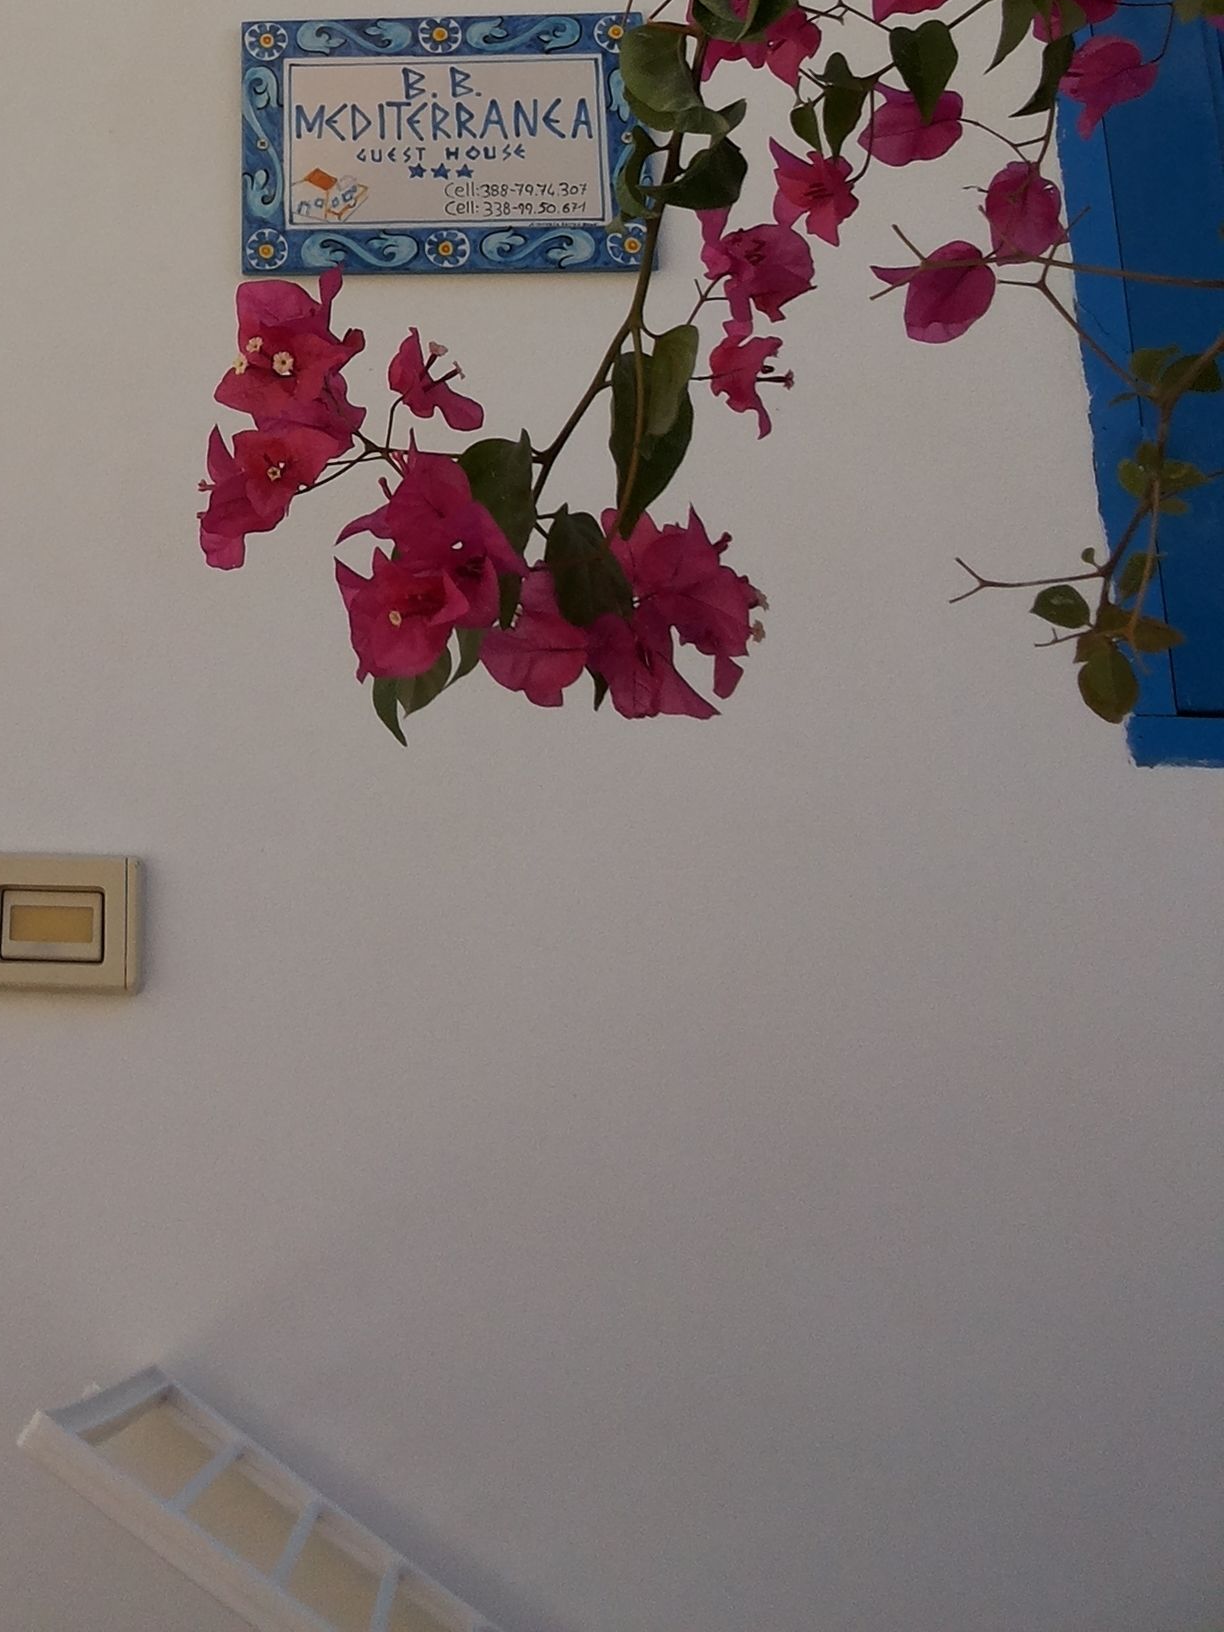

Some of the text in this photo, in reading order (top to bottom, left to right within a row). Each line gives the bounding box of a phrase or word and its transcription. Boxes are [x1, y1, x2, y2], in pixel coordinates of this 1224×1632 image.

[295, 98, 594, 141] MEDITERRANEA
[356, 143, 526, 163] GUEST HOUSE
